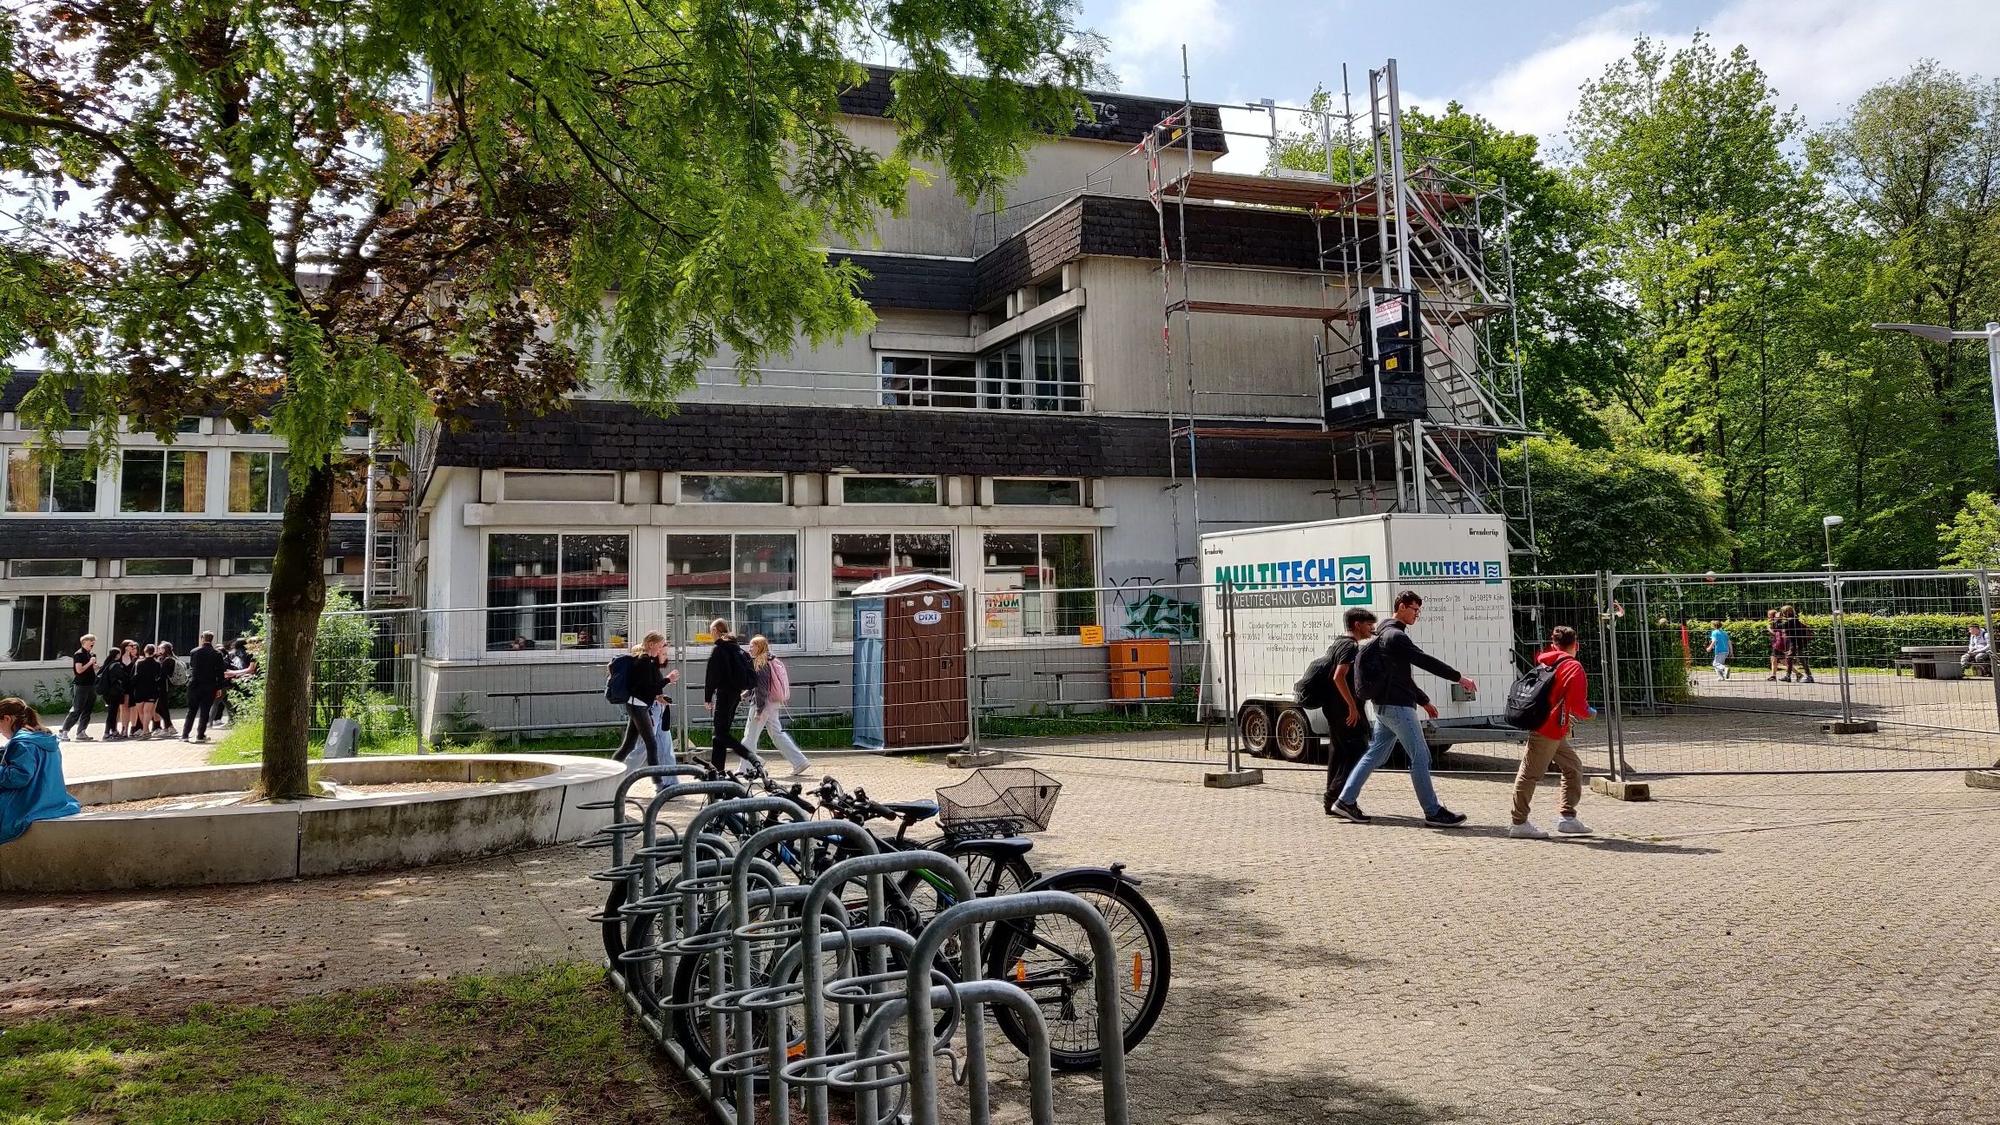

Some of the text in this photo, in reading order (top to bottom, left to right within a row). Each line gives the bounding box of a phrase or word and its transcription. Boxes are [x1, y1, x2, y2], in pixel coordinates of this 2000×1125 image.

[1215, 558, 1336, 592] MULTITECH
[1399, 561, 1479, 576] MULTITECH
[1217, 590, 1335, 609] UWELTTECHNIK GMBH
